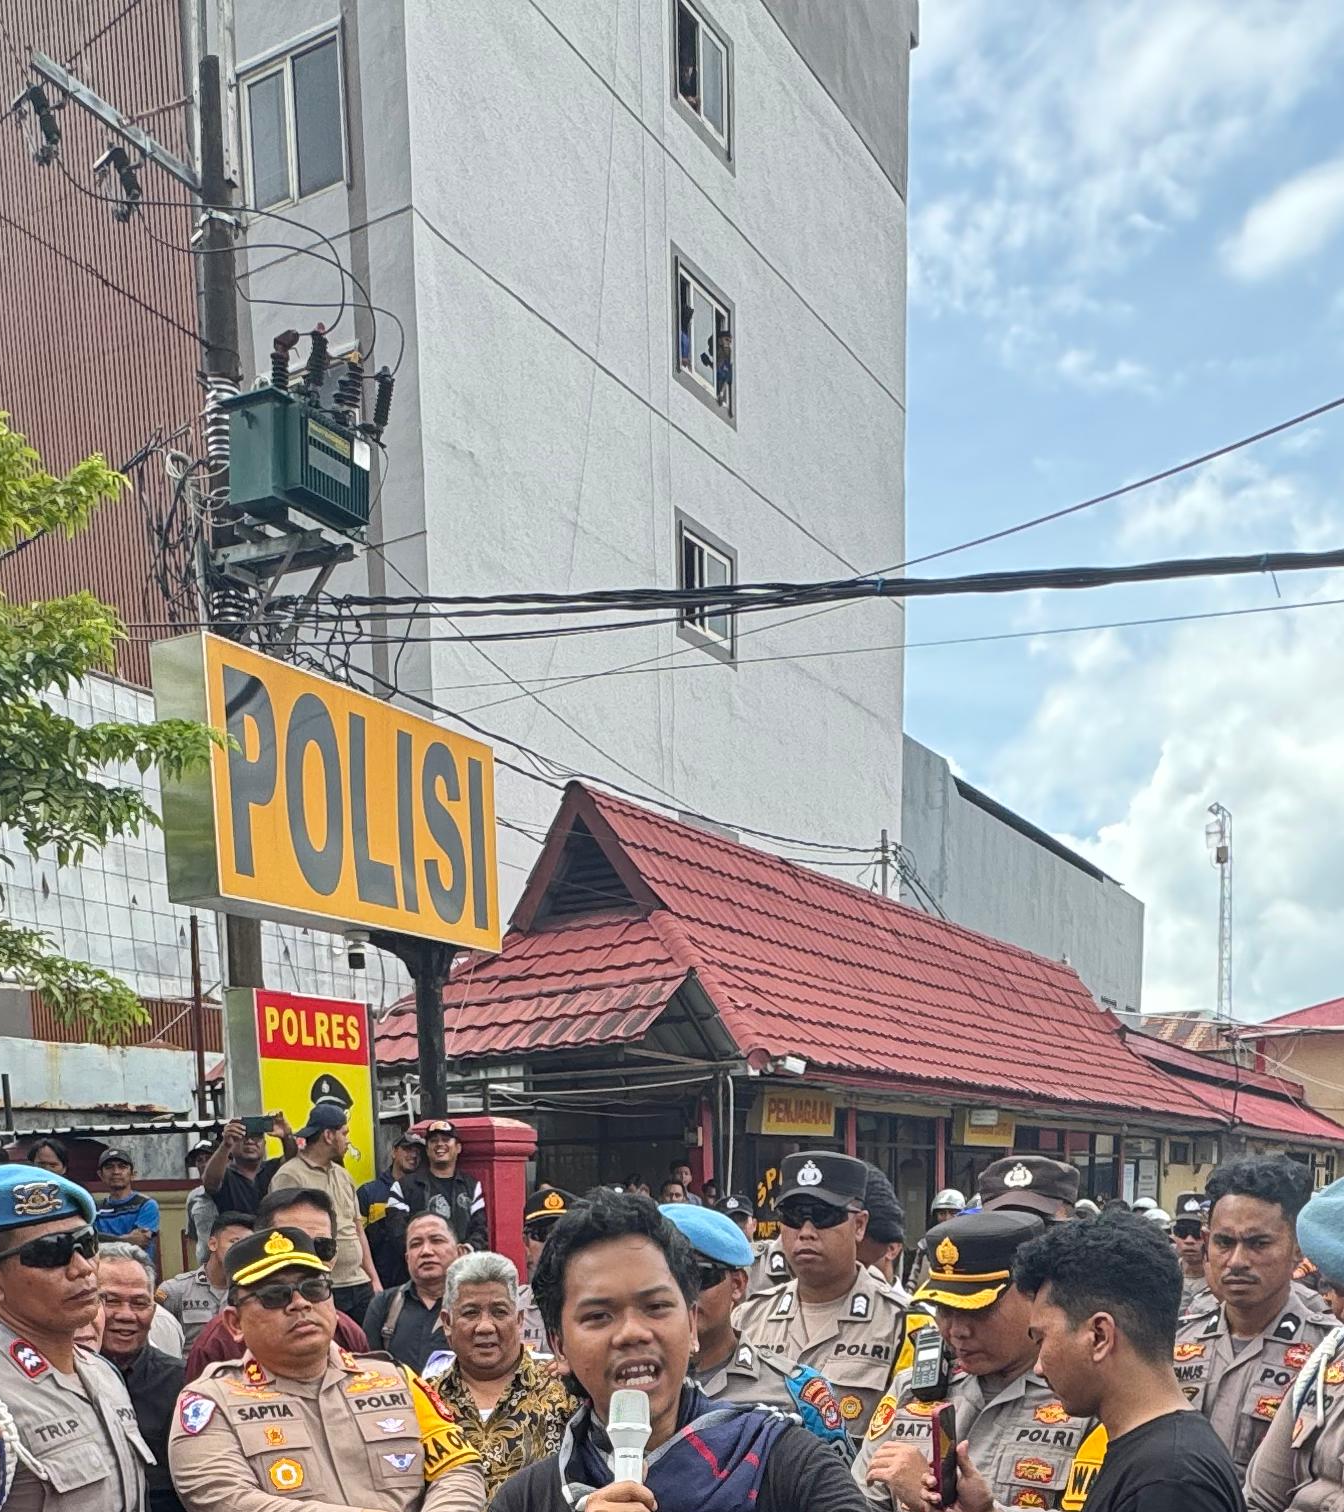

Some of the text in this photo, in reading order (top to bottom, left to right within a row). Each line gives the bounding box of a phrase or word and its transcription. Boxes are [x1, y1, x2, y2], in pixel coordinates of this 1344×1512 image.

[221, 664, 490, 930] POLISI
[264, 1006, 361, 1051] POLRES
[834, 1343, 890, 1360] POLRI
[354, 1392, 408, 1411] POLRI
[237, 1403, 294, 1421] SAPTIA
[1016, 1429, 1074, 1447] POLRI
